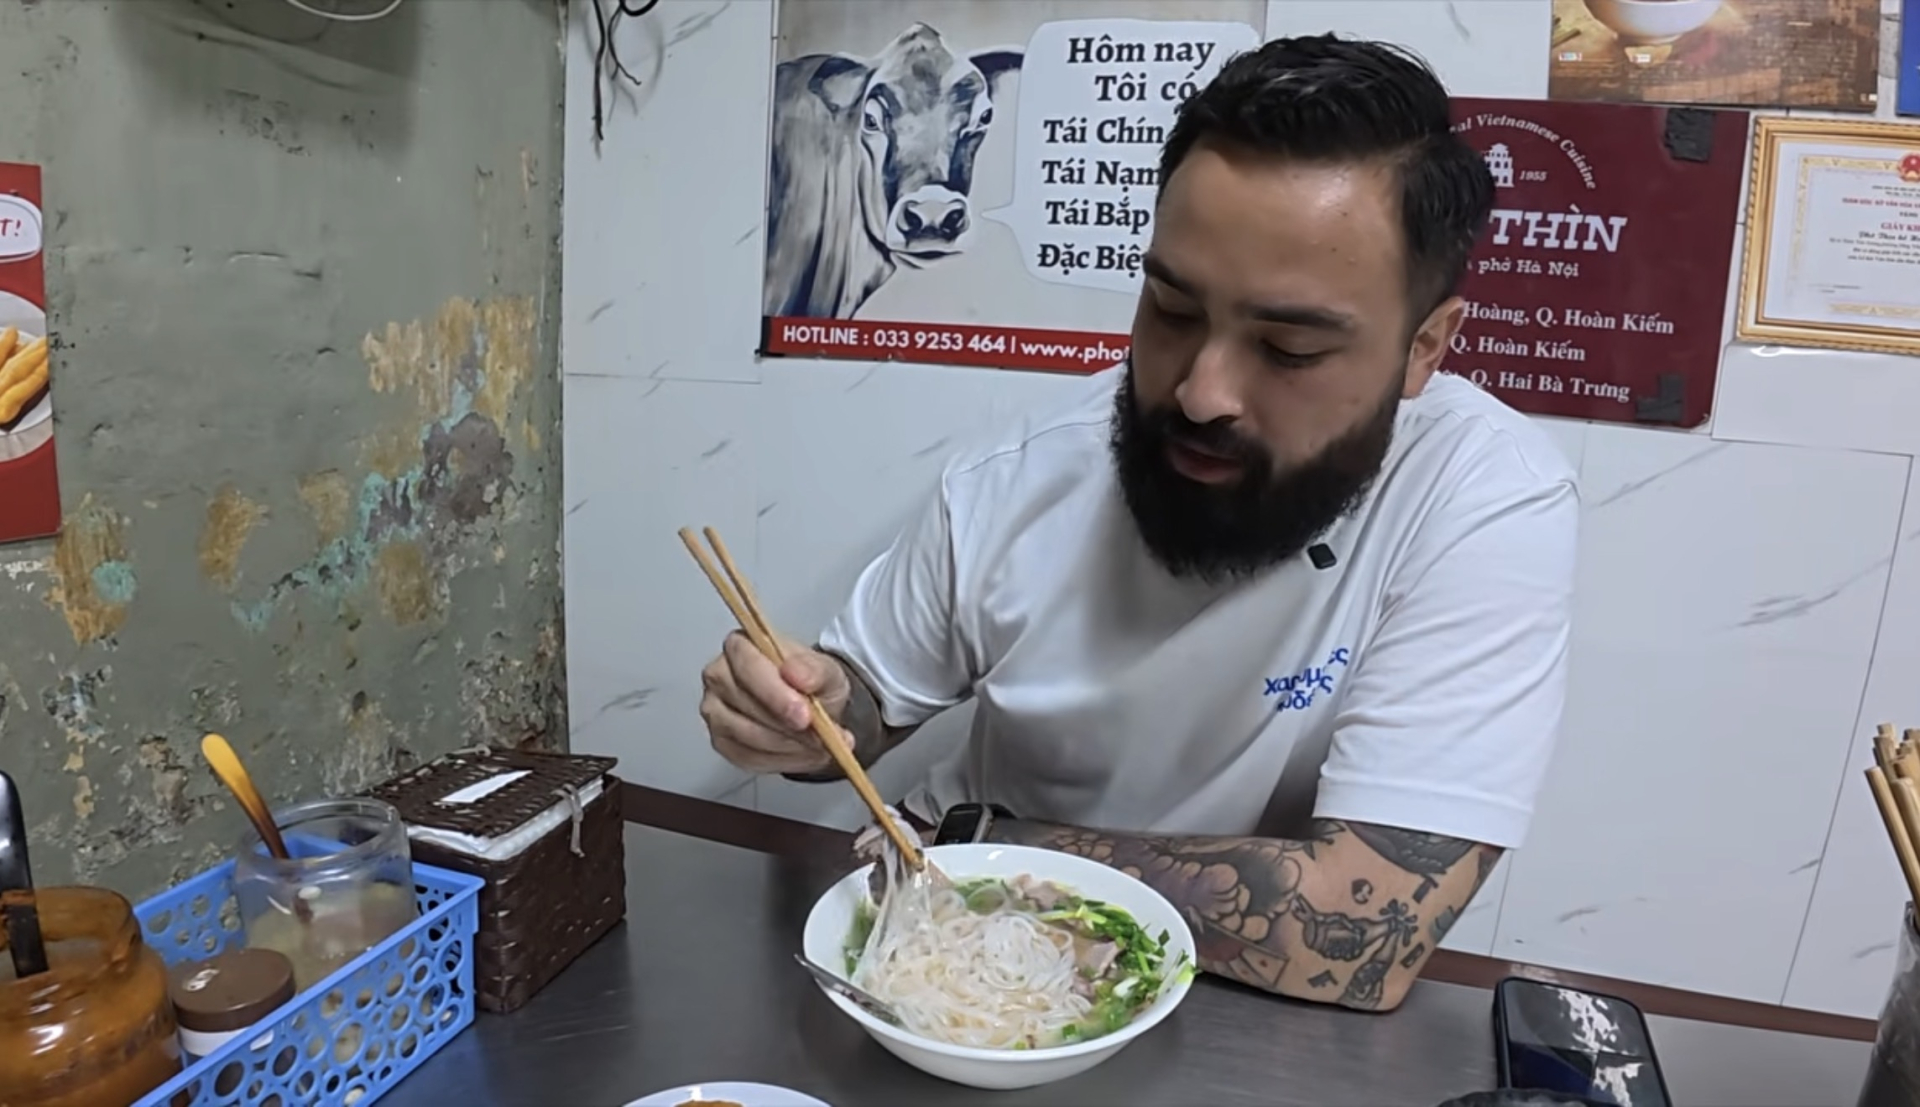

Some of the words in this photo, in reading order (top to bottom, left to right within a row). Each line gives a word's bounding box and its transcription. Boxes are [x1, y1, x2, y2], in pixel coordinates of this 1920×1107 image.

[1066, 33, 1146, 64] Hôm
[1153, 41, 1216, 71] nay
[1094, 71, 1147, 102] Tôi
[1160, 71, 1198, 100] có
[1043, 116, 1088, 144] Tái
[1096, 116, 1165, 144] Chín
[1476, 113, 1560, 143] Vietnamese
[1560, 138, 1597, 190] Cuisine
[1041, 157, 1086, 185] Tái
[1094, 160, 1161, 193] Nạm
[1045, 198, 1090, 226] Tái
[1093, 195, 1150, 235] Bắp
[1489, 203, 1629, 252] THÌN
[1036, 242, 1091, 276] Đặc
[1094, 243, 1146, 279] Biệ
[1477, 256, 1512, 275] phở
[1516, 259, 1543, 274] Hà
[1548, 261, 1580, 279] Nội
[1462, 301, 1531, 327] Hoàng,
[1535, 306, 1559, 328] Q.
[1564, 308, 1617, 330] Hoàn
[1622, 312, 1675, 335] Kiếm
[783, 324, 859, 346] HOTLINE
[873, 329, 910, 349] 033
[914, 331, 964, 351] 9253
[967, 333, 1006, 354] 464
[1449, 333, 1473, 355] Q.
[1477, 336, 1529, 357] Hoàn
[1534, 339, 1586, 362] Kiếm
[1470, 368, 1493, 388] Q.
[1498, 371, 1533, 391] Hai
[1538, 374, 1564, 394] Bà
[1570, 377, 1631, 404] Trưng
